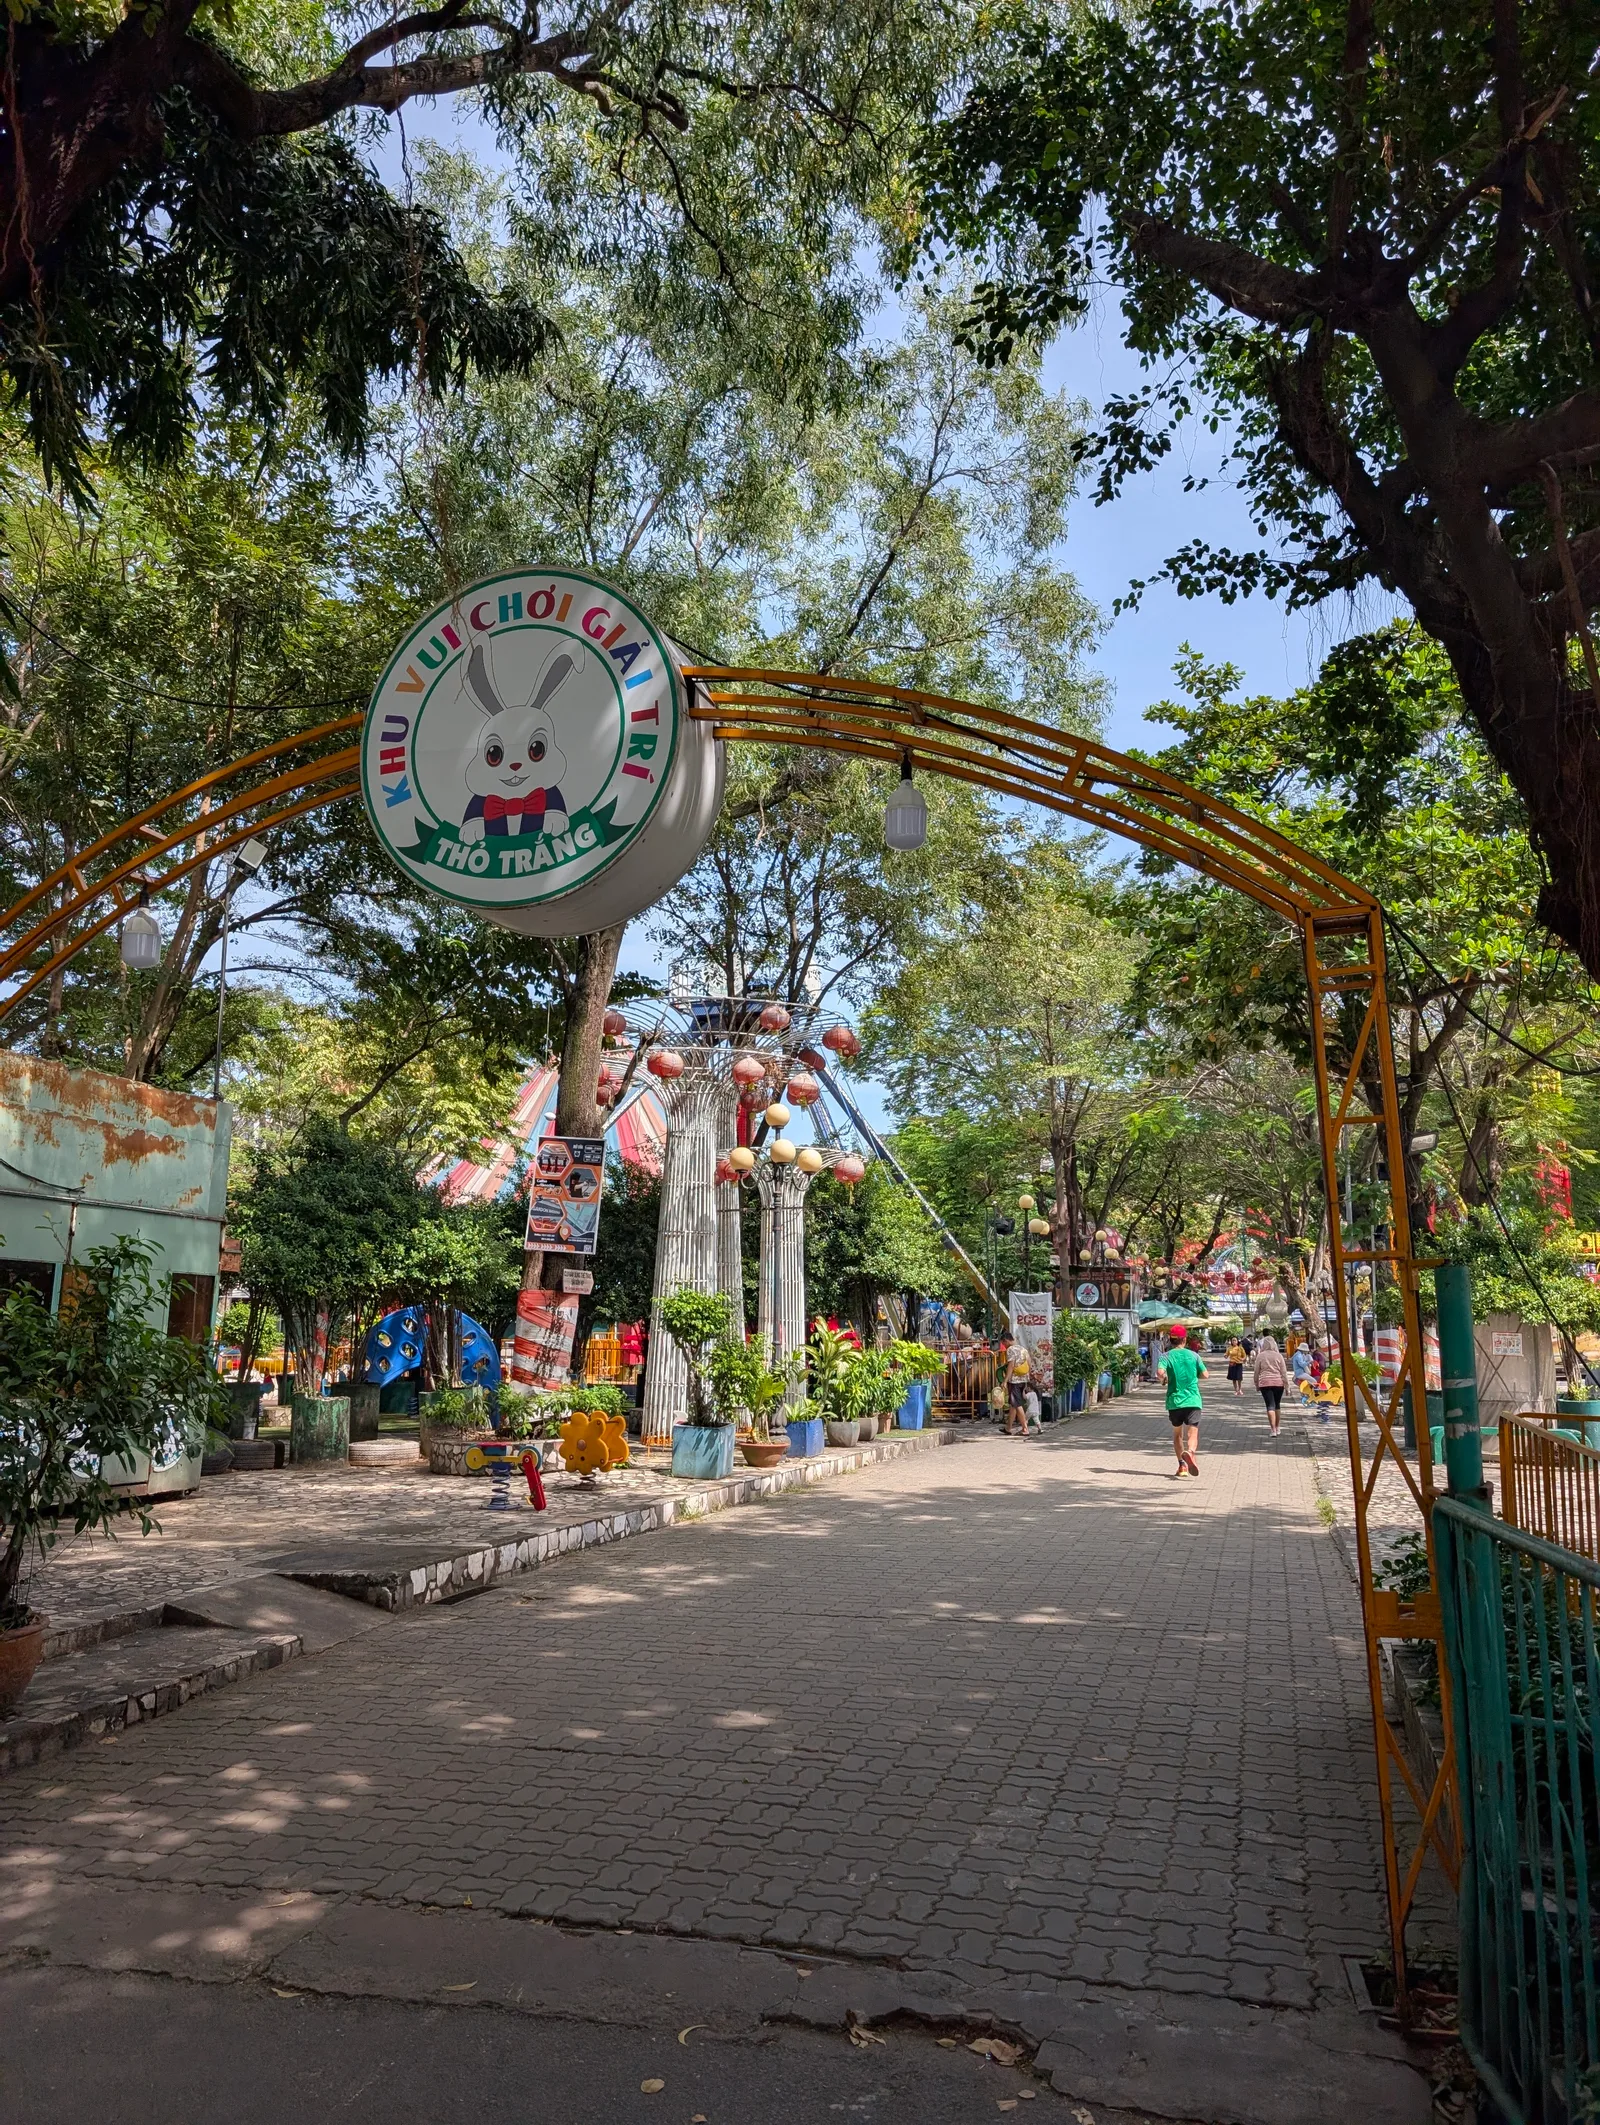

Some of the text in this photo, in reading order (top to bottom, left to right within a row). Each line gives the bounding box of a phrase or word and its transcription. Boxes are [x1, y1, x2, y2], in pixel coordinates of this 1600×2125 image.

[380, 584, 660, 808] KHU VUI CHƠI GIẢI TRÍ
[434, 822, 598, 875] THỎ TRẮNG
